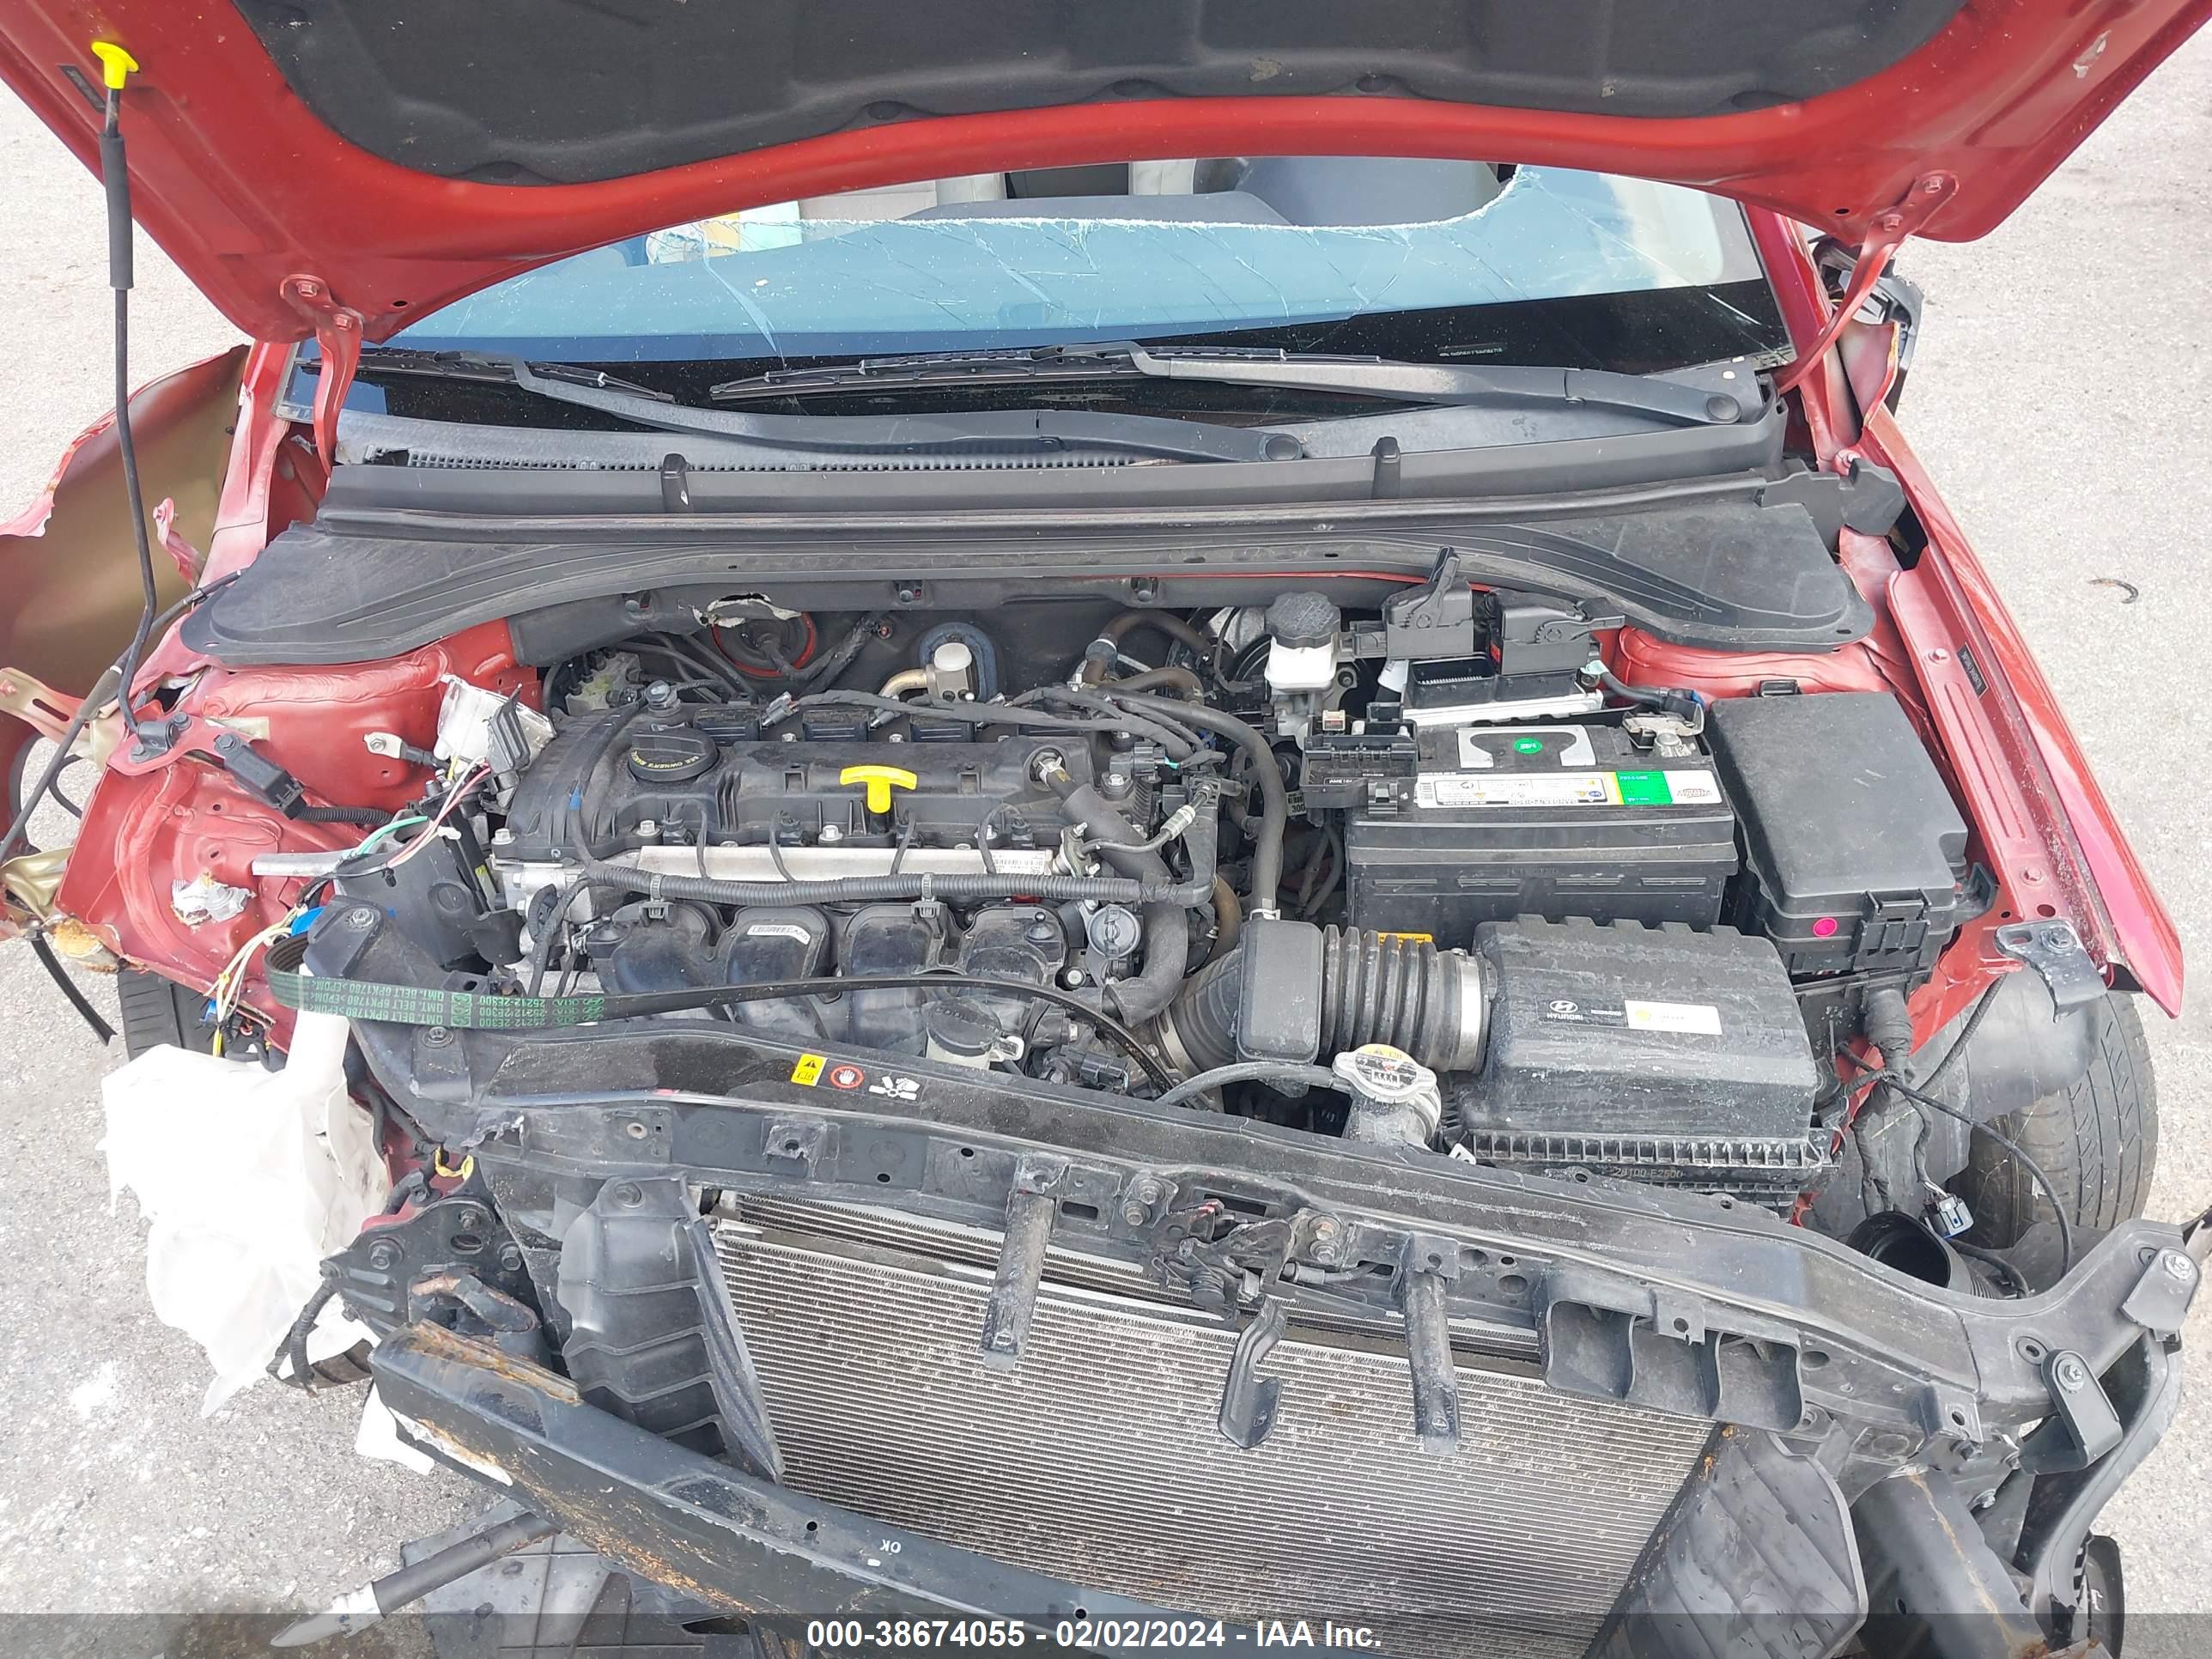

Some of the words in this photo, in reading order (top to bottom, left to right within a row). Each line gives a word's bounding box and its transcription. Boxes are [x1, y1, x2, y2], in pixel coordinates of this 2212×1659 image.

[349, 982, 392, 996] 6PK1780
[391, 987, 417, 998] BELT
[347, 994, 391, 1008] 6PK1780
[392, 999, 416, 1012] BELT
[479, 996, 546, 1007] 25212-2E300
[345, 1006, 390, 1020] 6PK1780
[390, 1011, 416, 1023] BELT
[479, 1006, 546, 1018] 25212-2E300
[1547, 1012, 1583, 1021] HYUNDAI
[479, 1017, 546, 1027] 25212-2E300
[879, 1538, 902, 1554] OK
